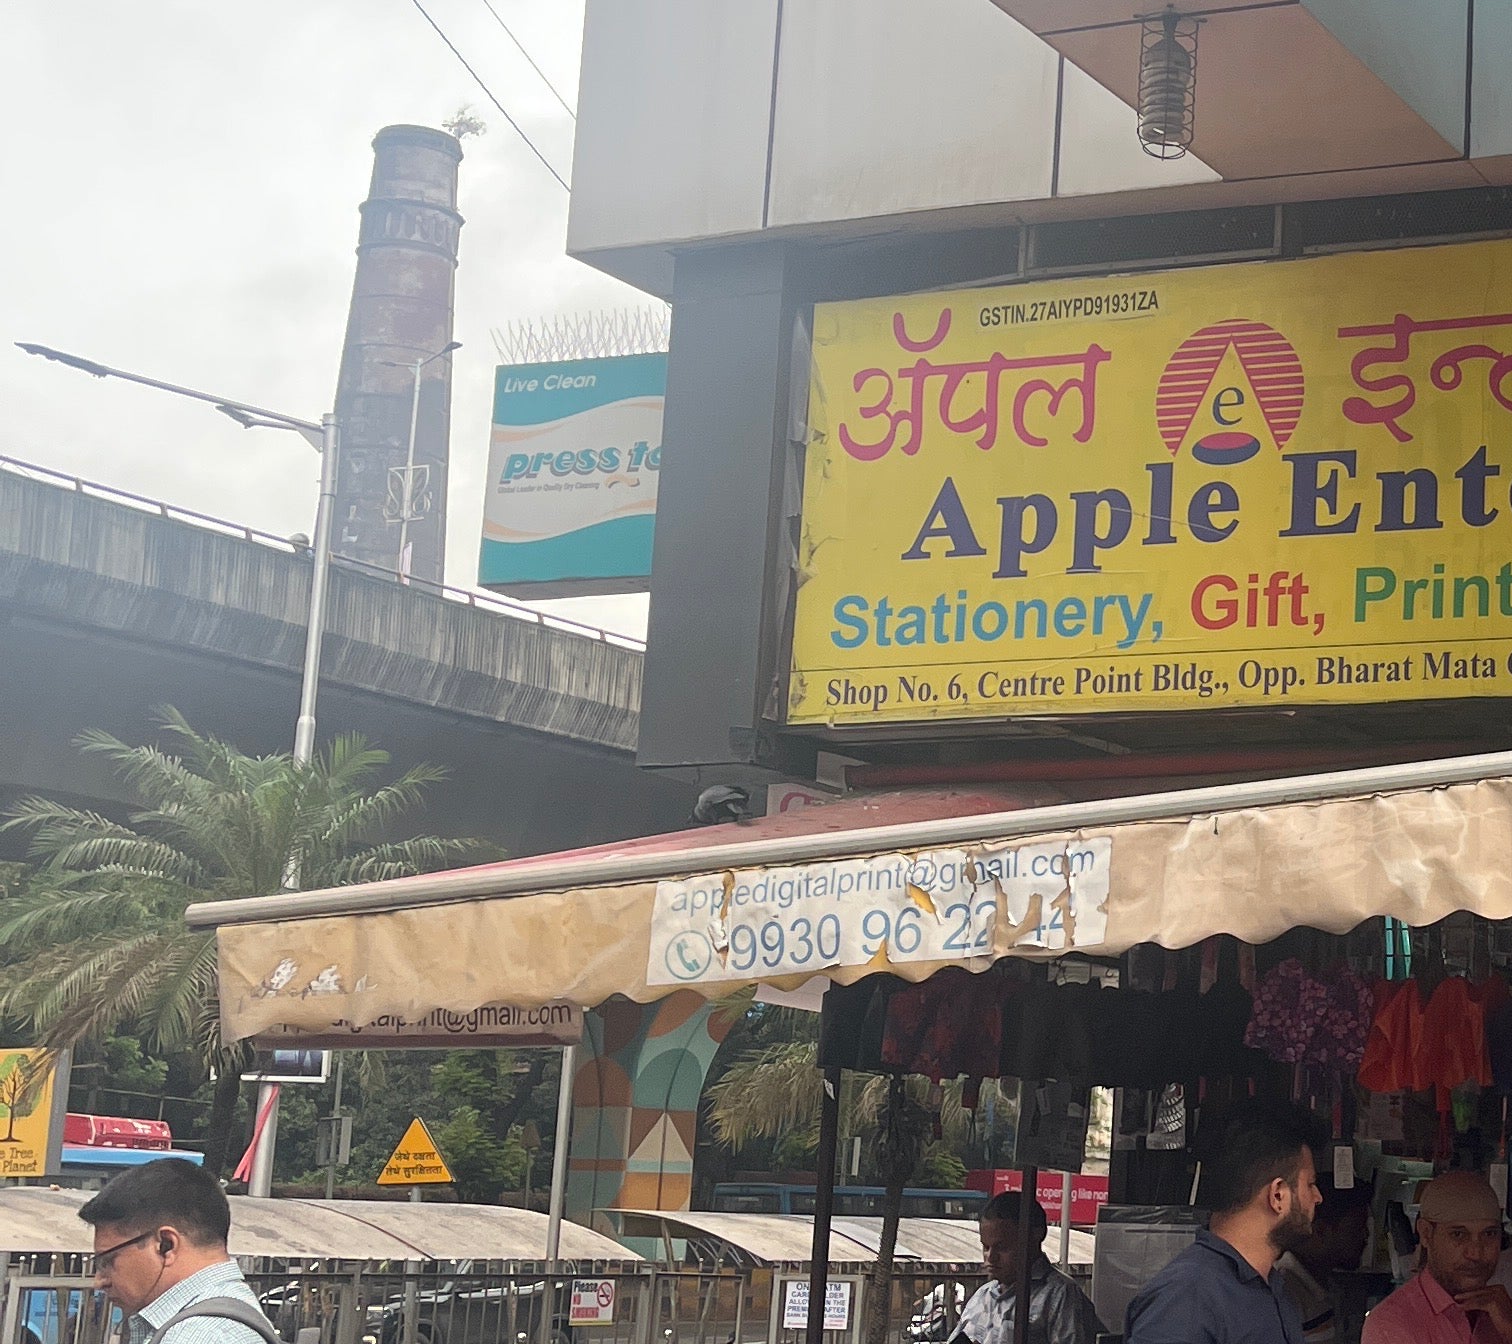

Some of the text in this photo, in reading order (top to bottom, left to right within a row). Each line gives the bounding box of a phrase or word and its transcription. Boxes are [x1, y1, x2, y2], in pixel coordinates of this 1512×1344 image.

[504, 374, 597, 394] Live Clean
[499, 446, 622, 485] press
[901, 462, 1242, 580] Apple
[830, 587, 1166, 649] Stationery,
[1190, 569, 1327, 637] Gift,
[826, 678, 888, 711] Shop
[897, 674, 939, 705] No.
[945, 673, 970, 704] 6,
[977, 667, 1065, 700] Centre
[1074, 662, 1143, 695] Point
[1152, 658, 1230, 697] Bldg.,
[1238, 658, 1306, 696] Opp.
[1316, 651, 1413, 687] Bharat
[1422, 650, 1497, 682] Mata
[671, 849, 1095, 916] appedigitalprint@gmail.com
[730, 912, 840, 971] 9930
[862, 906, 923, 956] 96
[3, 1160, 37, 1172] Planet
[9, 1147, 33, 1158] Tree
